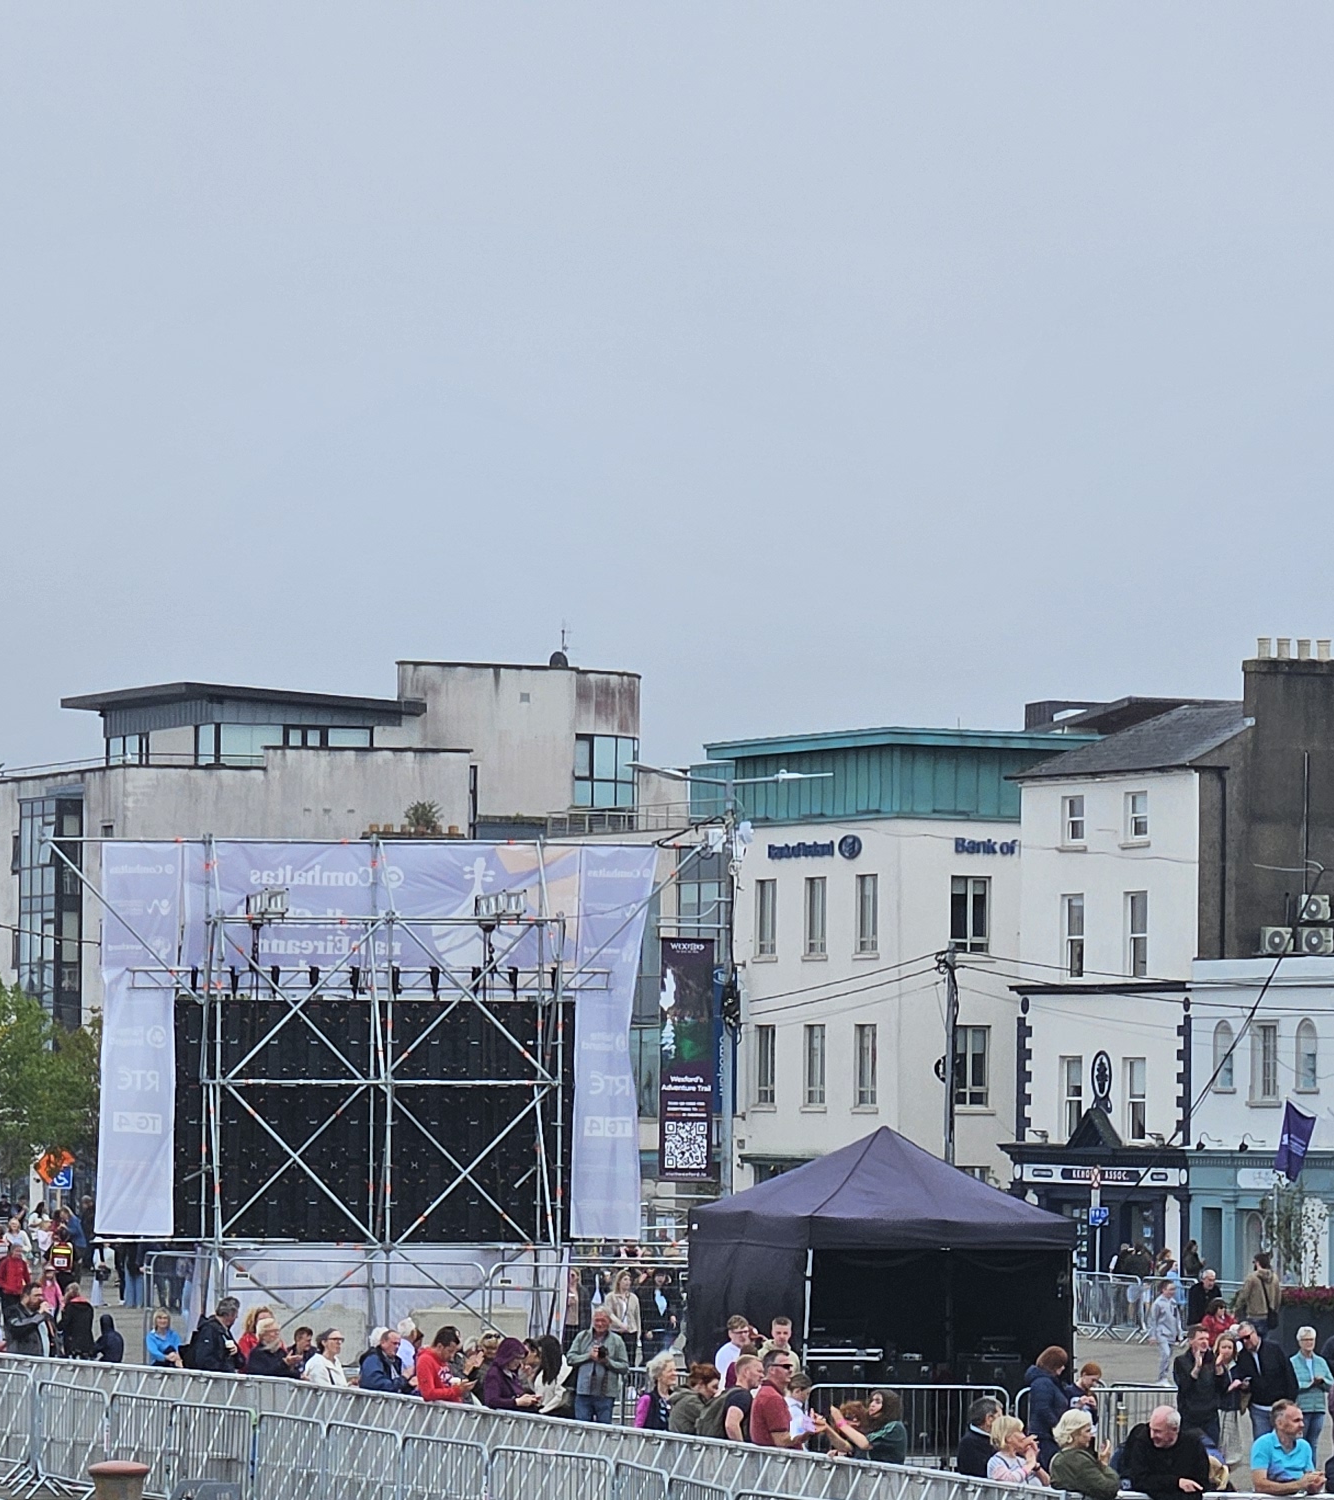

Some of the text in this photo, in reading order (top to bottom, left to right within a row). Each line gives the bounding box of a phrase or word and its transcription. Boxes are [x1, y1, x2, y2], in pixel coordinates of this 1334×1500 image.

[955, 837, 1018, 856] Bank of
[661, 1084, 696, 1092] Adventure
